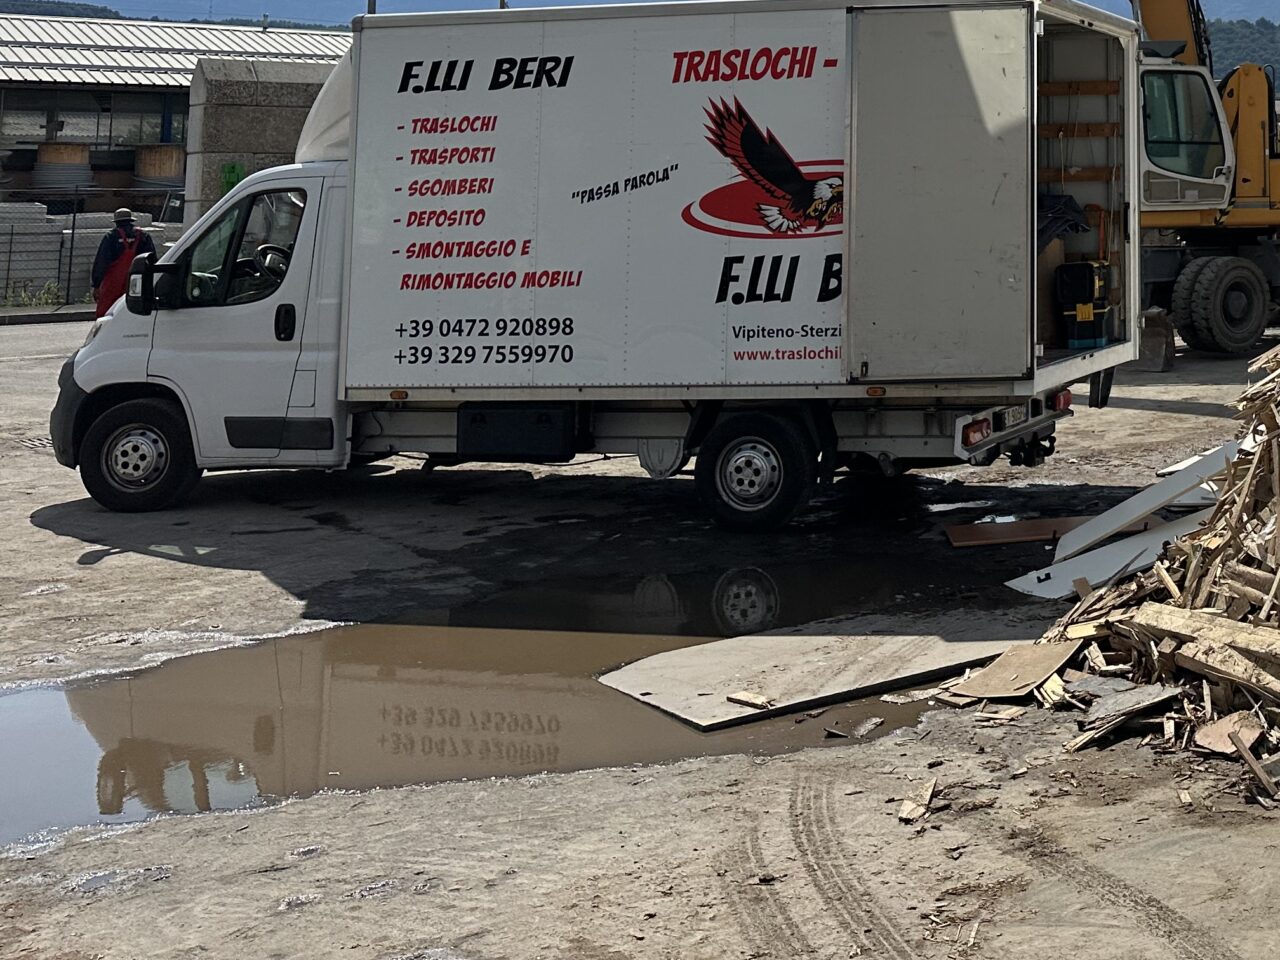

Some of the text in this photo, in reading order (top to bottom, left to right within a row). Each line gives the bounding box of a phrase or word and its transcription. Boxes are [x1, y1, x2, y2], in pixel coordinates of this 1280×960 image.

[397, 56, 575, 94] F.LLI BERI
[672, 46, 818, 84] TRASLOCHI
[411, 115, 498, 134] TRASLOCHI
[410, 147, 497, 165] TRASPORTI
[408, 177, 495, 197] SGOMBERI
[571, 163, 679, 204] "PASSA PAROLA"
[406, 208, 486, 228] DEPOSITO
[405, 239, 516, 259] SMONTAGGIO
[520, 239, 532, 256] E
[400, 270, 583, 291] RIMONTAGGIO MOBILI
[715, 254, 801, 305] F.LLI
[395, 317, 574, 338] +39 0472 920898
[394, 344, 574, 365] +39 329 7559970
